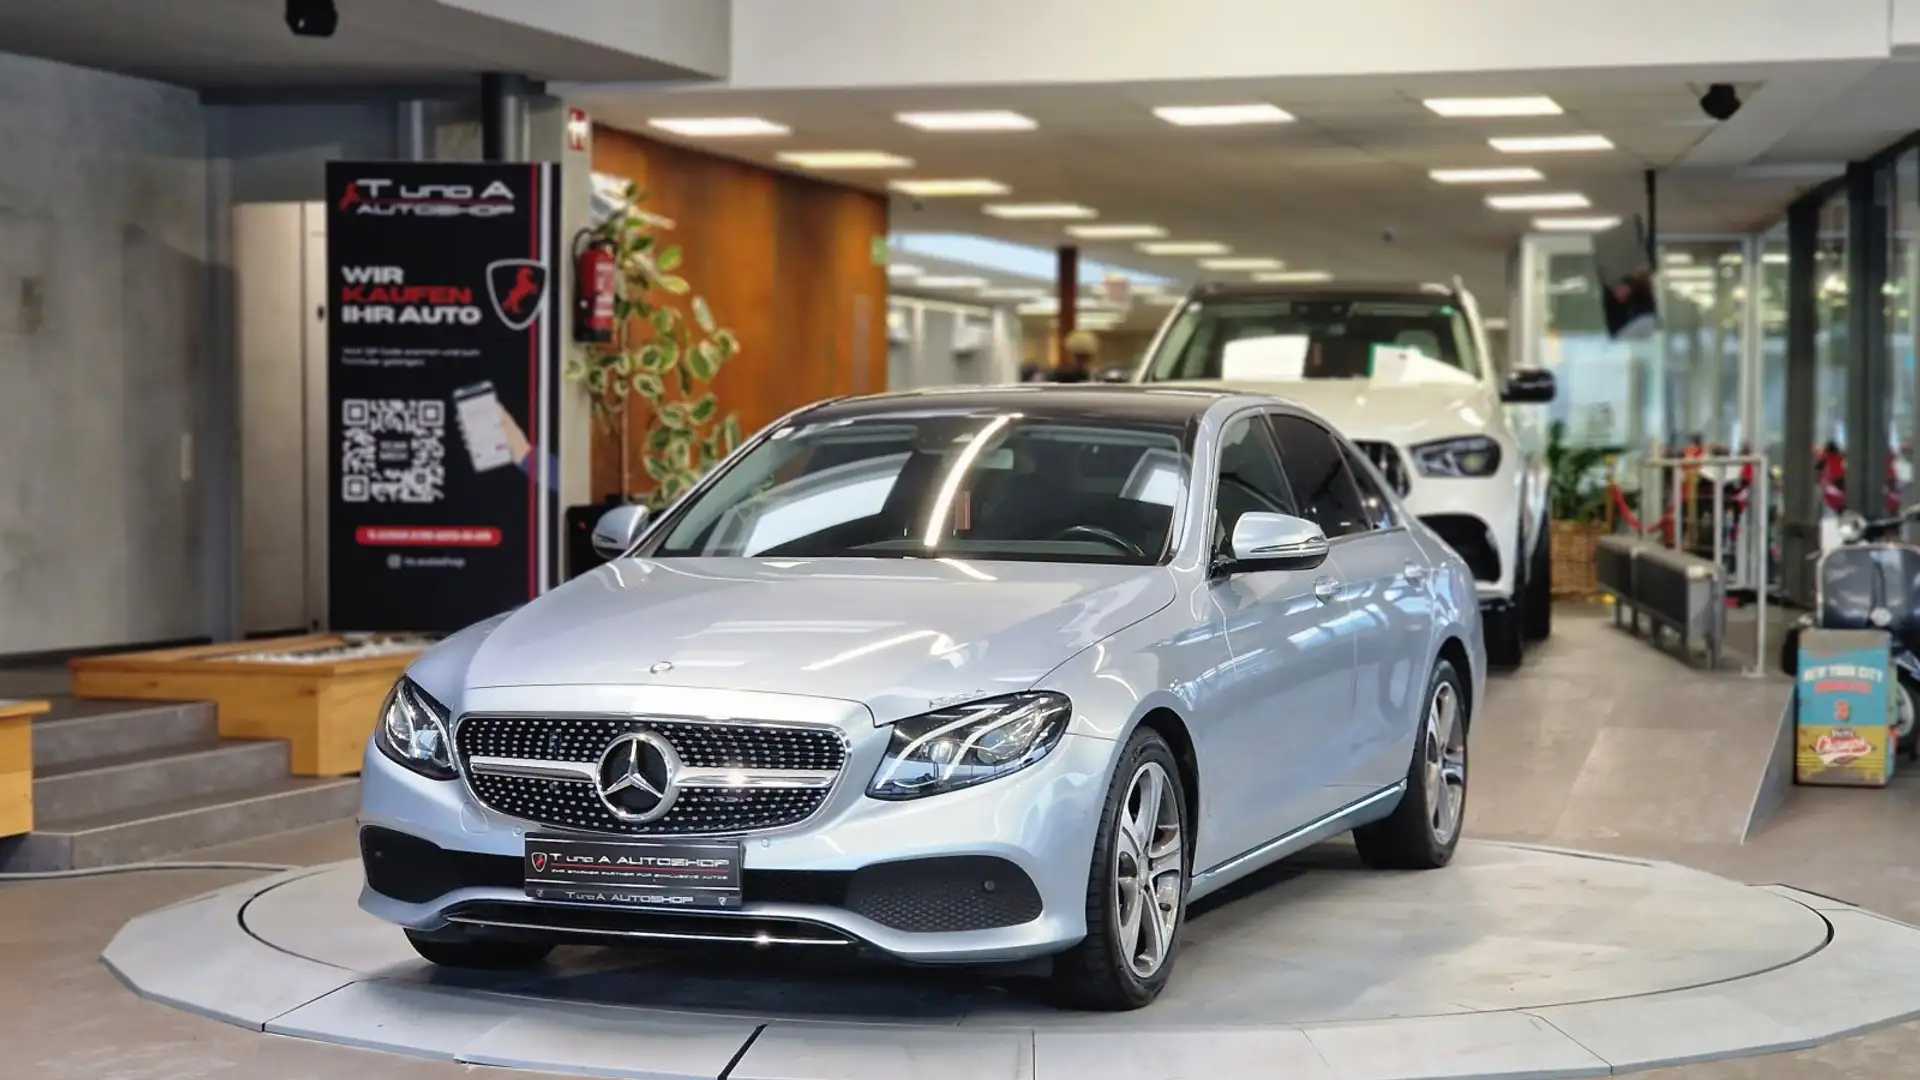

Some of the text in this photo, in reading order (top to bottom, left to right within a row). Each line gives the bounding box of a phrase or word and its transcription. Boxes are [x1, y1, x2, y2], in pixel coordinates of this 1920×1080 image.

[356, 179, 392, 198] T
[480, 180, 516, 200] A
[356, 204, 516, 217] AUTOSHOP
[342, 265, 403, 284] WIR
[341, 286, 473, 304] KAUFEN
[342, 305, 483, 325] IHR AUTO
[549, 853, 562, 861] T
[598, 855, 611, 864] A
[616, 856, 730, 868] AUTOSHOP
[610, 893, 694, 904] AUTOSHOP
